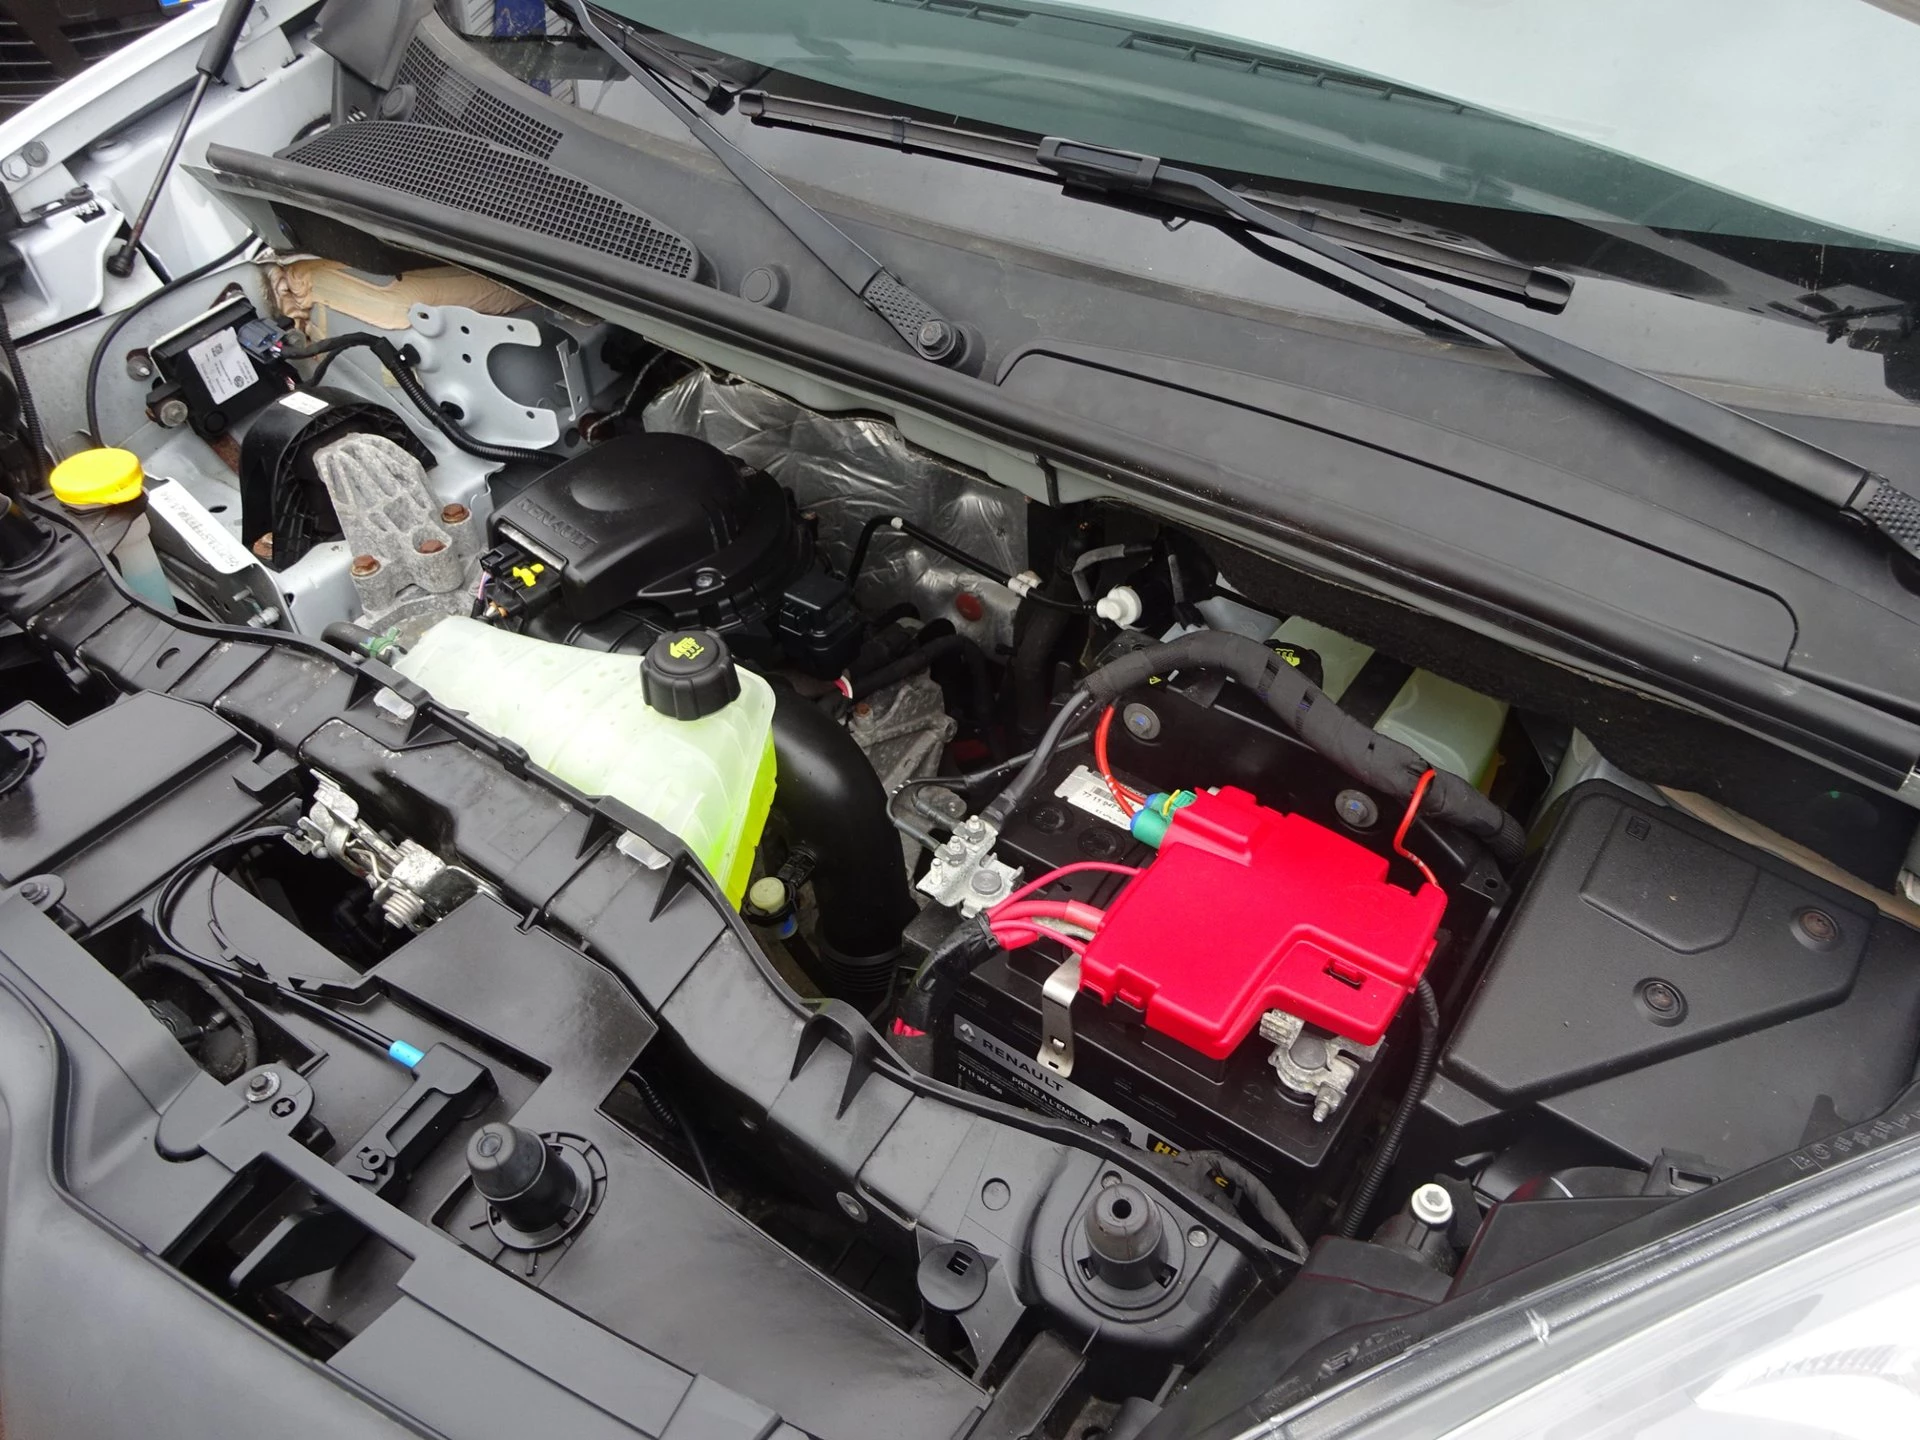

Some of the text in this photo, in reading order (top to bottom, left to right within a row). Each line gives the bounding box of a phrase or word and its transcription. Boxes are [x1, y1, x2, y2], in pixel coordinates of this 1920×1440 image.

[516, 497, 599, 551] RENAULT
[982, 1038, 1064, 1092] RENAULT
[1011, 1075, 1040, 1096] PRÊTE
